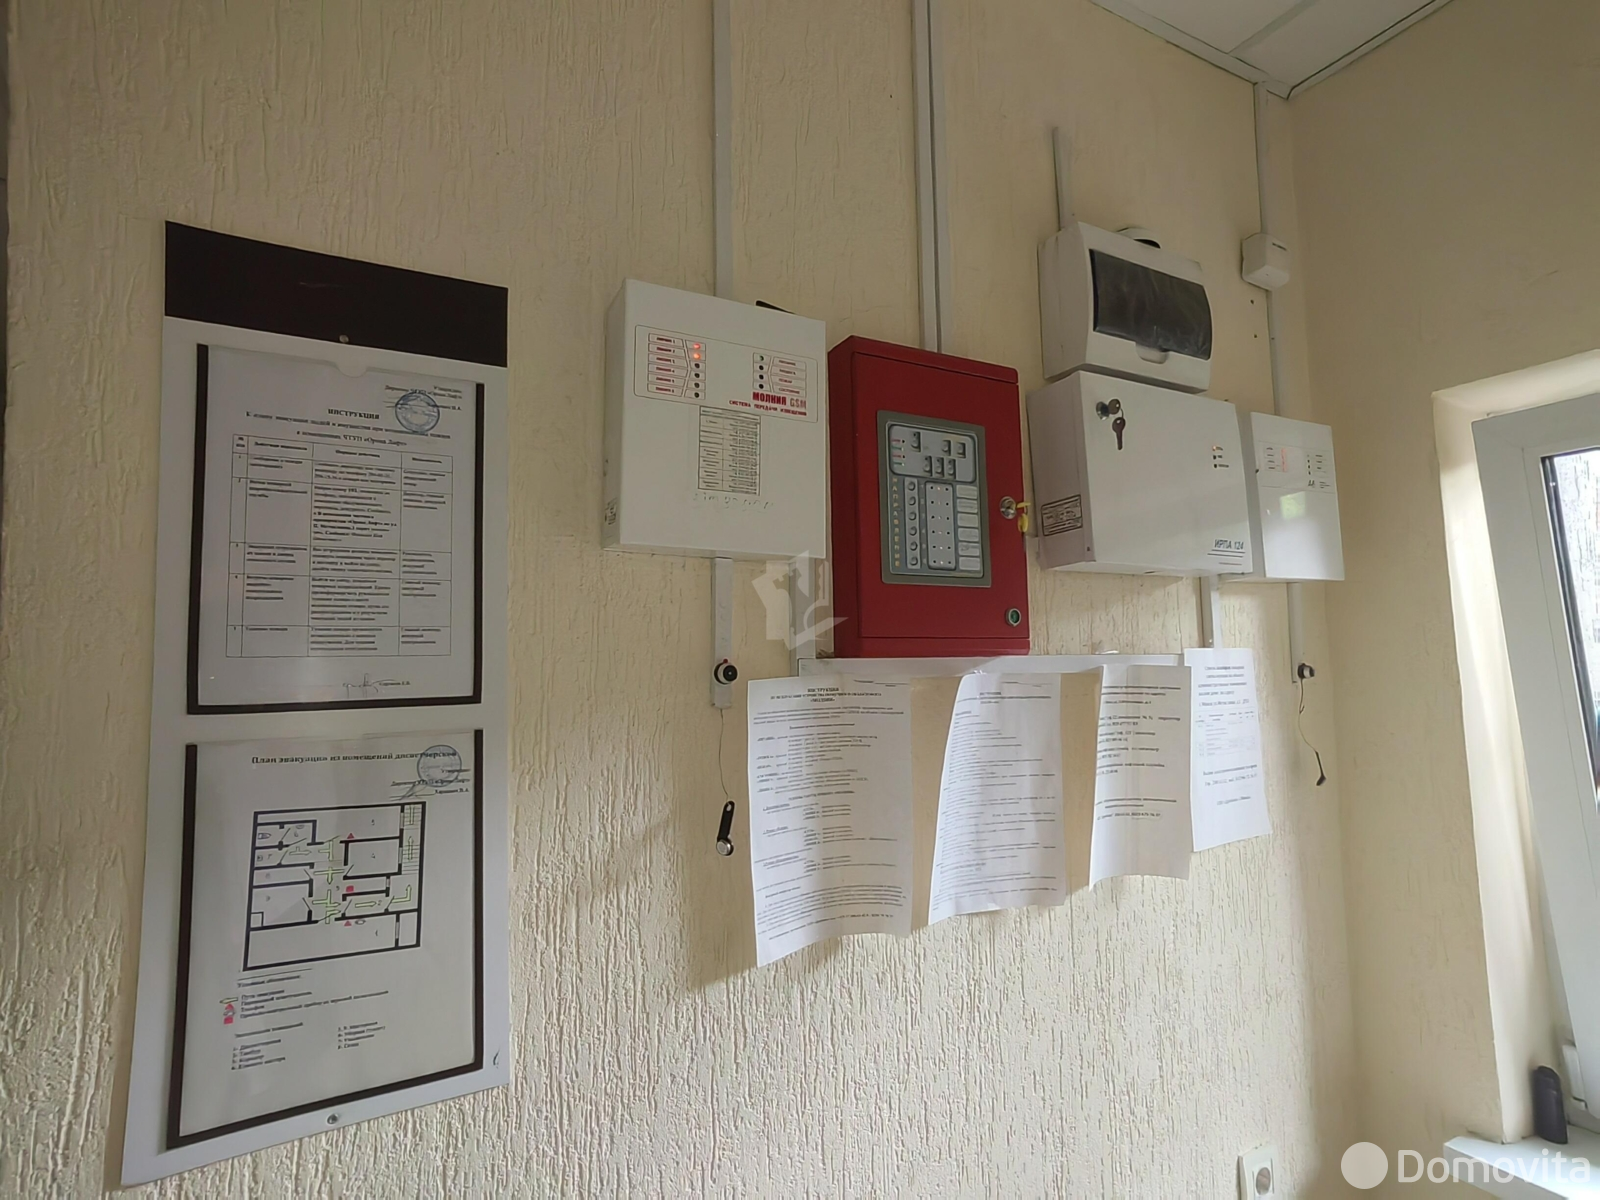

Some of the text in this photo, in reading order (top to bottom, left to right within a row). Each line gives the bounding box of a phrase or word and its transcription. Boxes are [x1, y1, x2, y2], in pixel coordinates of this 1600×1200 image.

[752, 392, 807, 410] МОЛНИЯ GSM
[327, 408, 380, 420] ИНСТРУКЦИЯ
